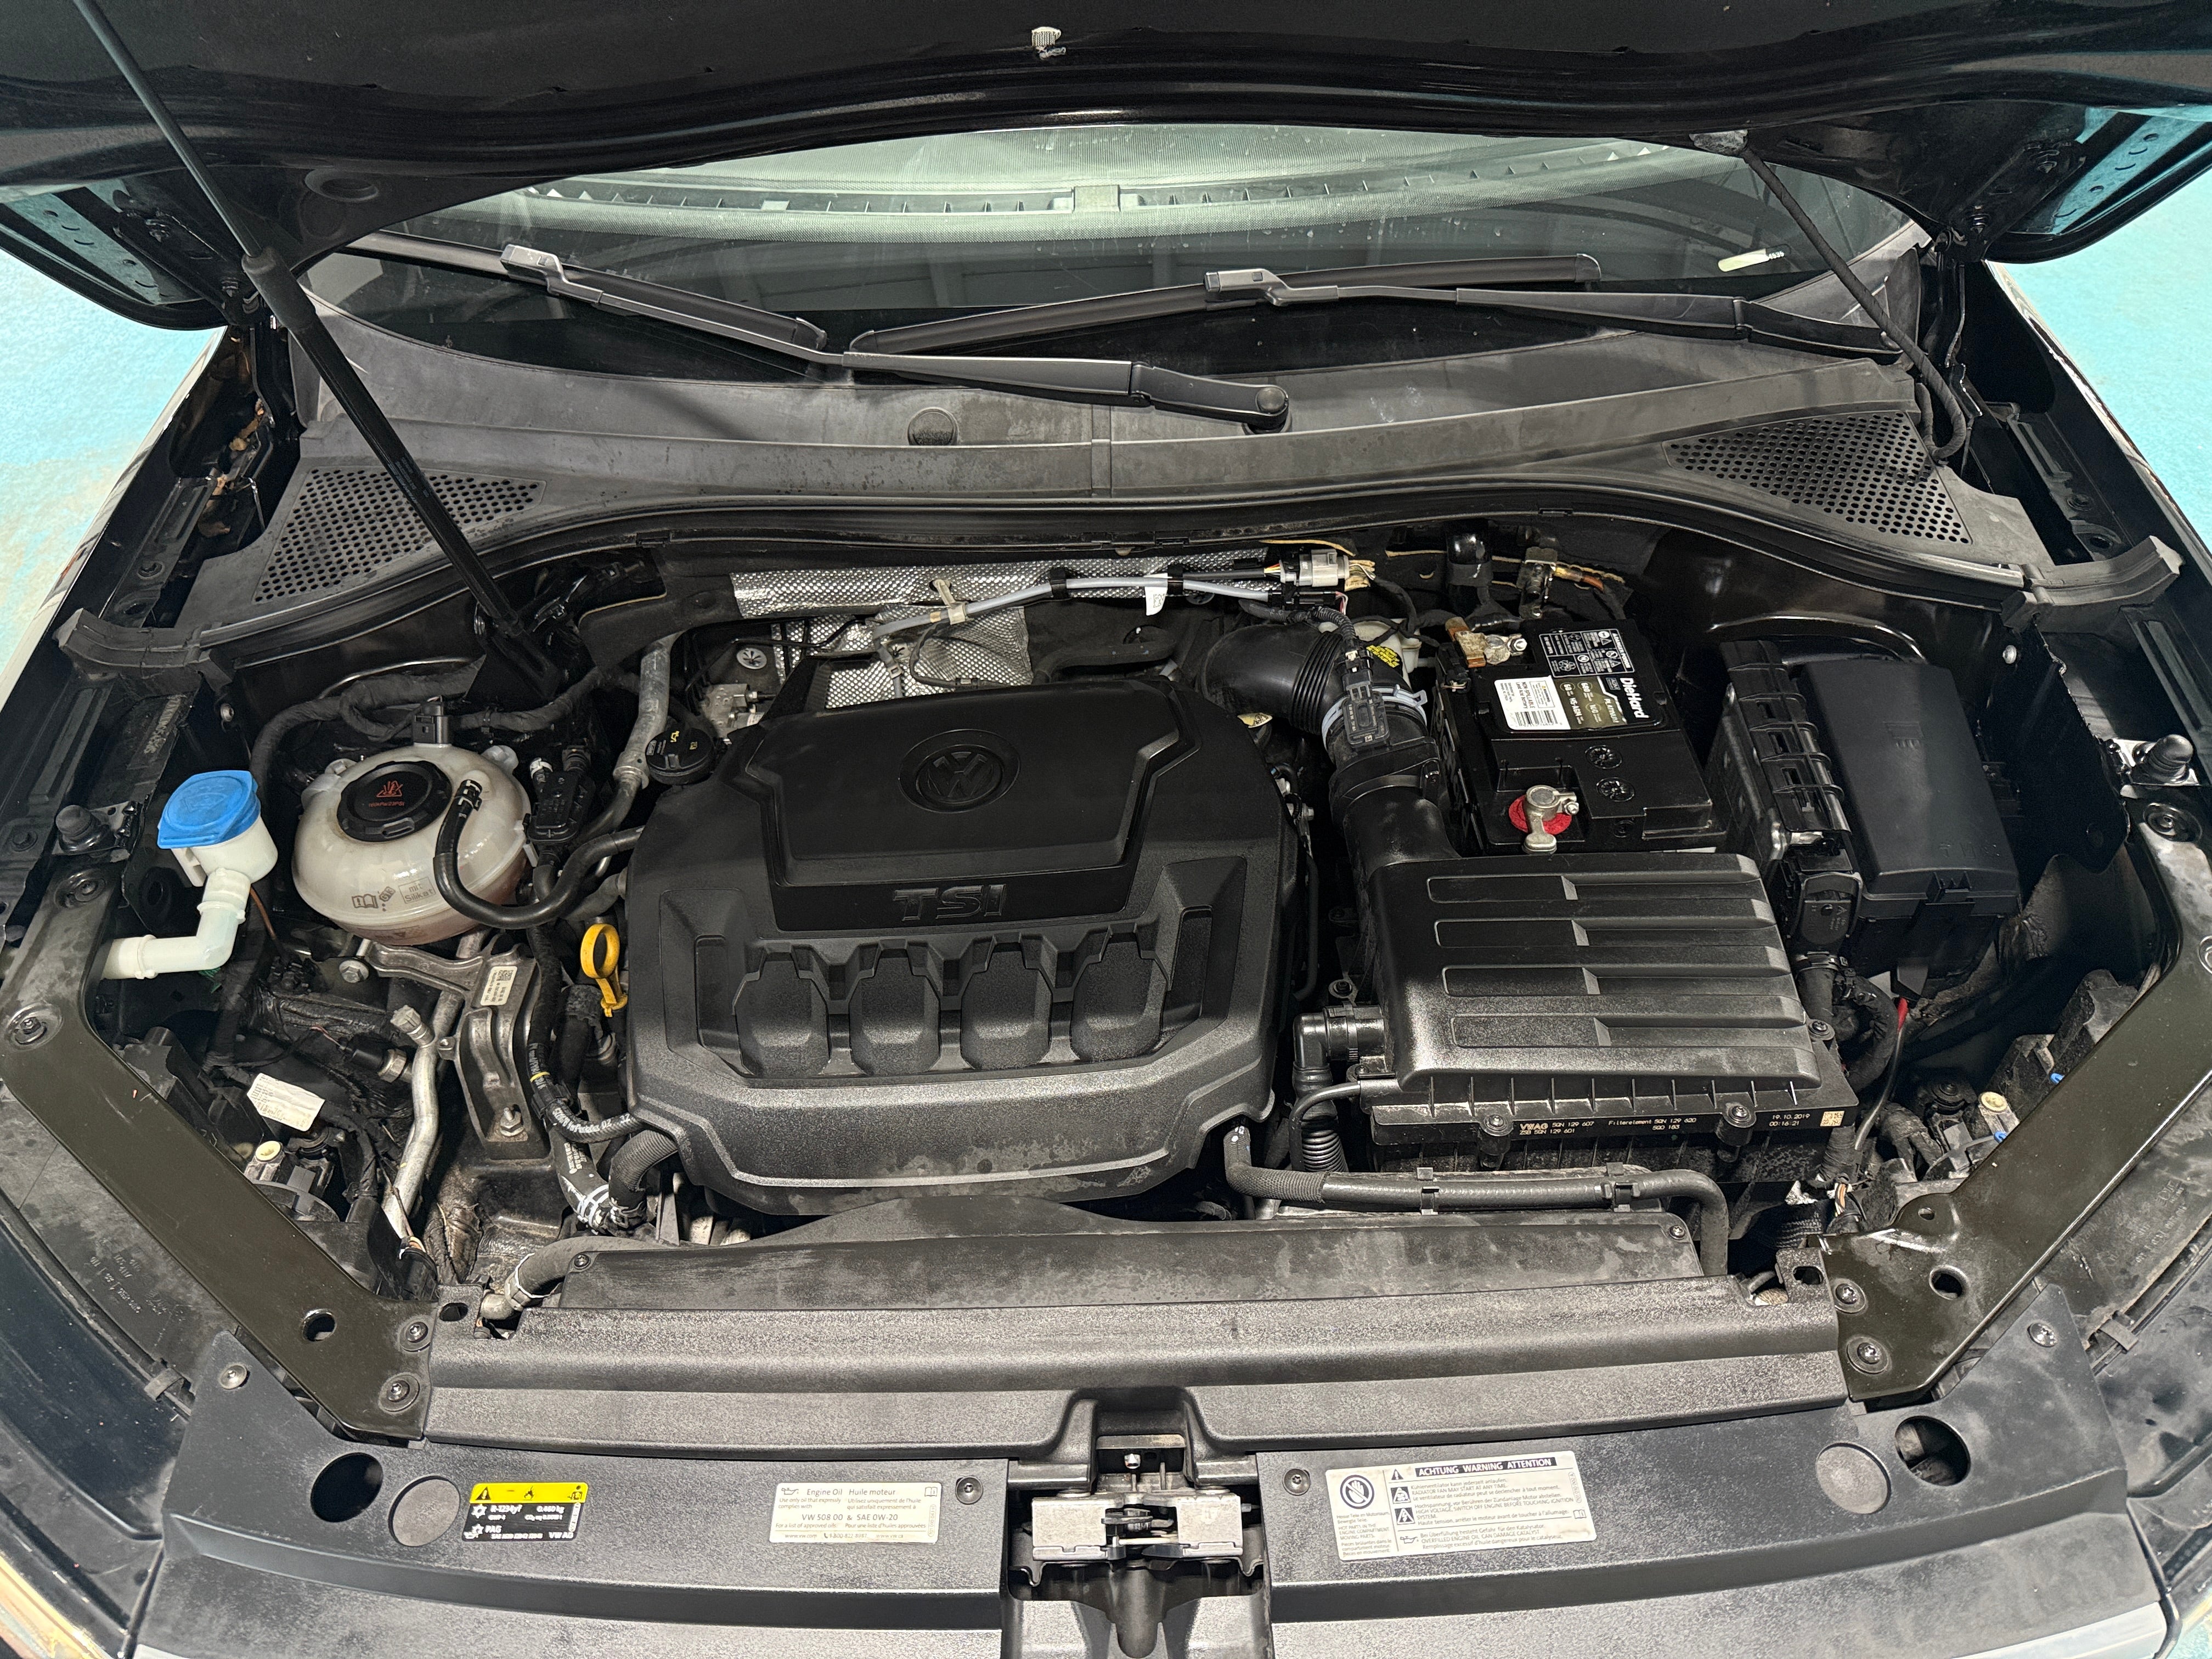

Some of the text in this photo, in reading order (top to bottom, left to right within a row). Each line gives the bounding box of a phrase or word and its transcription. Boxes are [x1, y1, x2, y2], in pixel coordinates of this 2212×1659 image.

[1620, 678, 1649, 718] DieHard
[1604, 699, 1619, 723] PLATINUM
[409, 883, 423, 892] mit
[405, 889, 434, 902] Silikat
[893, 884, 1006, 921] TSI
[1419, 1458, 1551, 1476] ACHTUNG WARNING ATTENTION
[807, 1489, 831, 1497] Engine
[556, 1505, 565, 1514] kg
